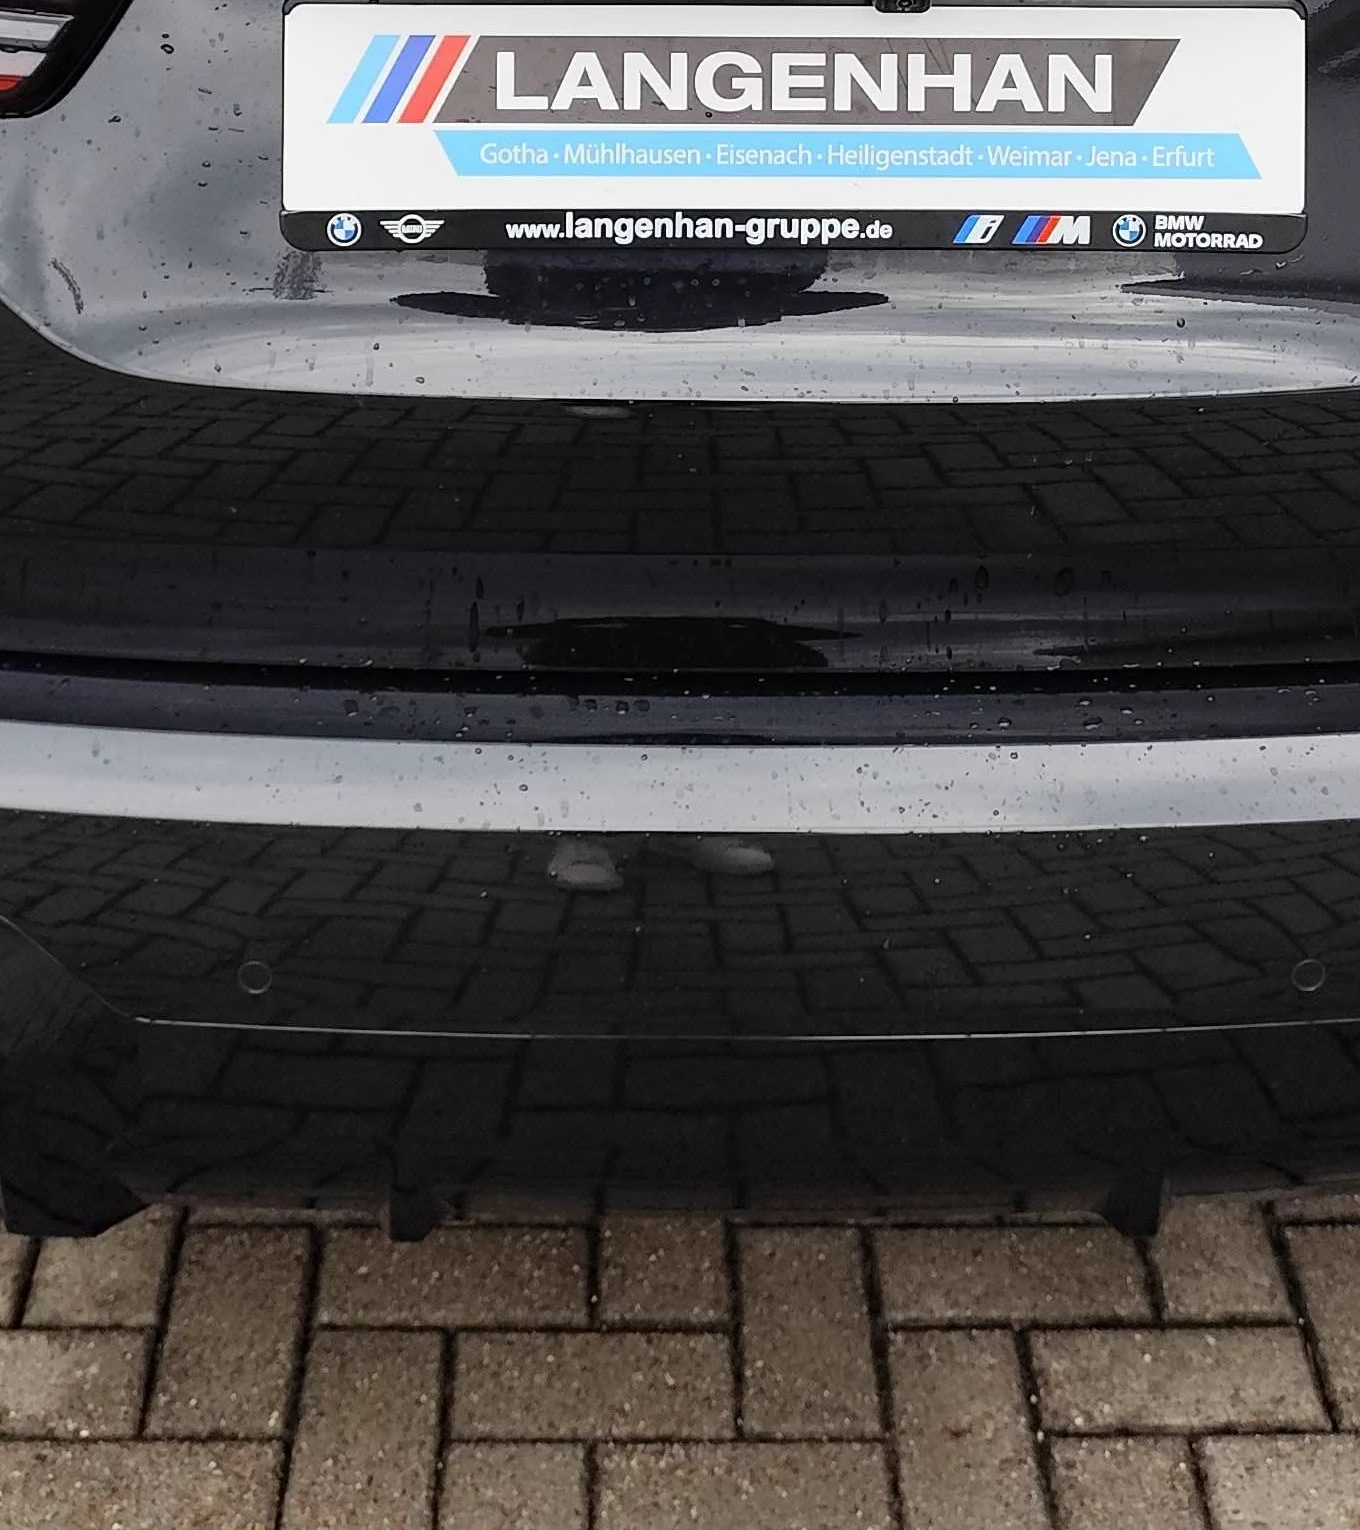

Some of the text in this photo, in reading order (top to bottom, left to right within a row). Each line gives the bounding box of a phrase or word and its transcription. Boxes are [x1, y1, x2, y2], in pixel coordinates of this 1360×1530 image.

[496, 51, 1113, 113] LANGENHAN
[480, 143, 1215, 171] Gotha Mühlhausen Eisenach Heiligenstadt Weimar Jena Erfurt
[505, 211, 893, 245] www.langenhan-gruppe.de
[1154, 215, 1205, 231] BMW
[1153, 232, 1264, 249] MOTORRAD
